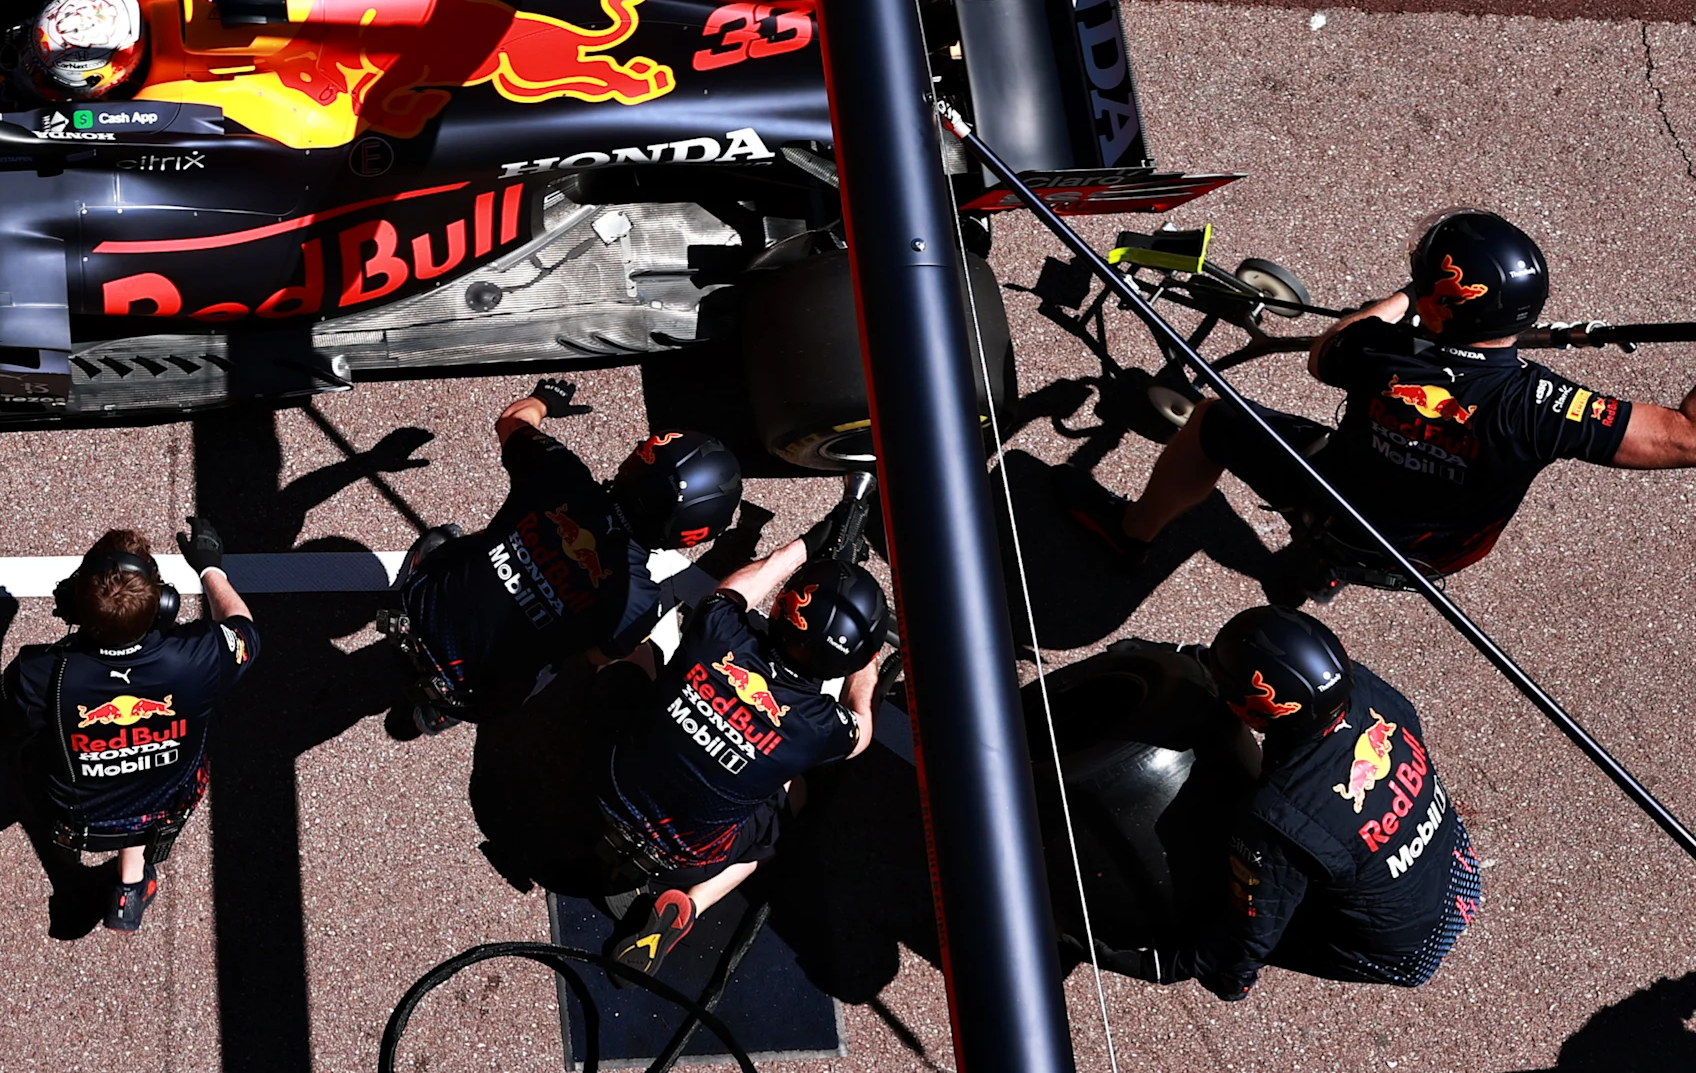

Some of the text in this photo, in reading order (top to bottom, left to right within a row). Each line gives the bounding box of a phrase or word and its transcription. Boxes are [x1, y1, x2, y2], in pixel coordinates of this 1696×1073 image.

[36, 130, 116, 141] HONDA
[98, 111, 159, 126] Cash App
[497, 126, 776, 179] HONDA
[338, 182, 525, 309] Bull
[1370, 418, 1469, 468] HONDA
[1371, 433, 1436, 475] Mobil
[488, 542, 536, 607] Mobil
[508, 529, 565, 619] HONDA
[100, 644, 143, 657] HONDA
[70, 718, 187, 753] Red Bull
[666, 697, 728, 758] Mobil
[681, 683, 758, 760] HONDA
[683, 662, 783, 756] Red Bull
[78, 739, 181, 762] HONDA
[81, 755, 151, 777] Mobil
[1358, 726, 1430, 854] Red Bull
[1386, 800, 1445, 879] Mobil
